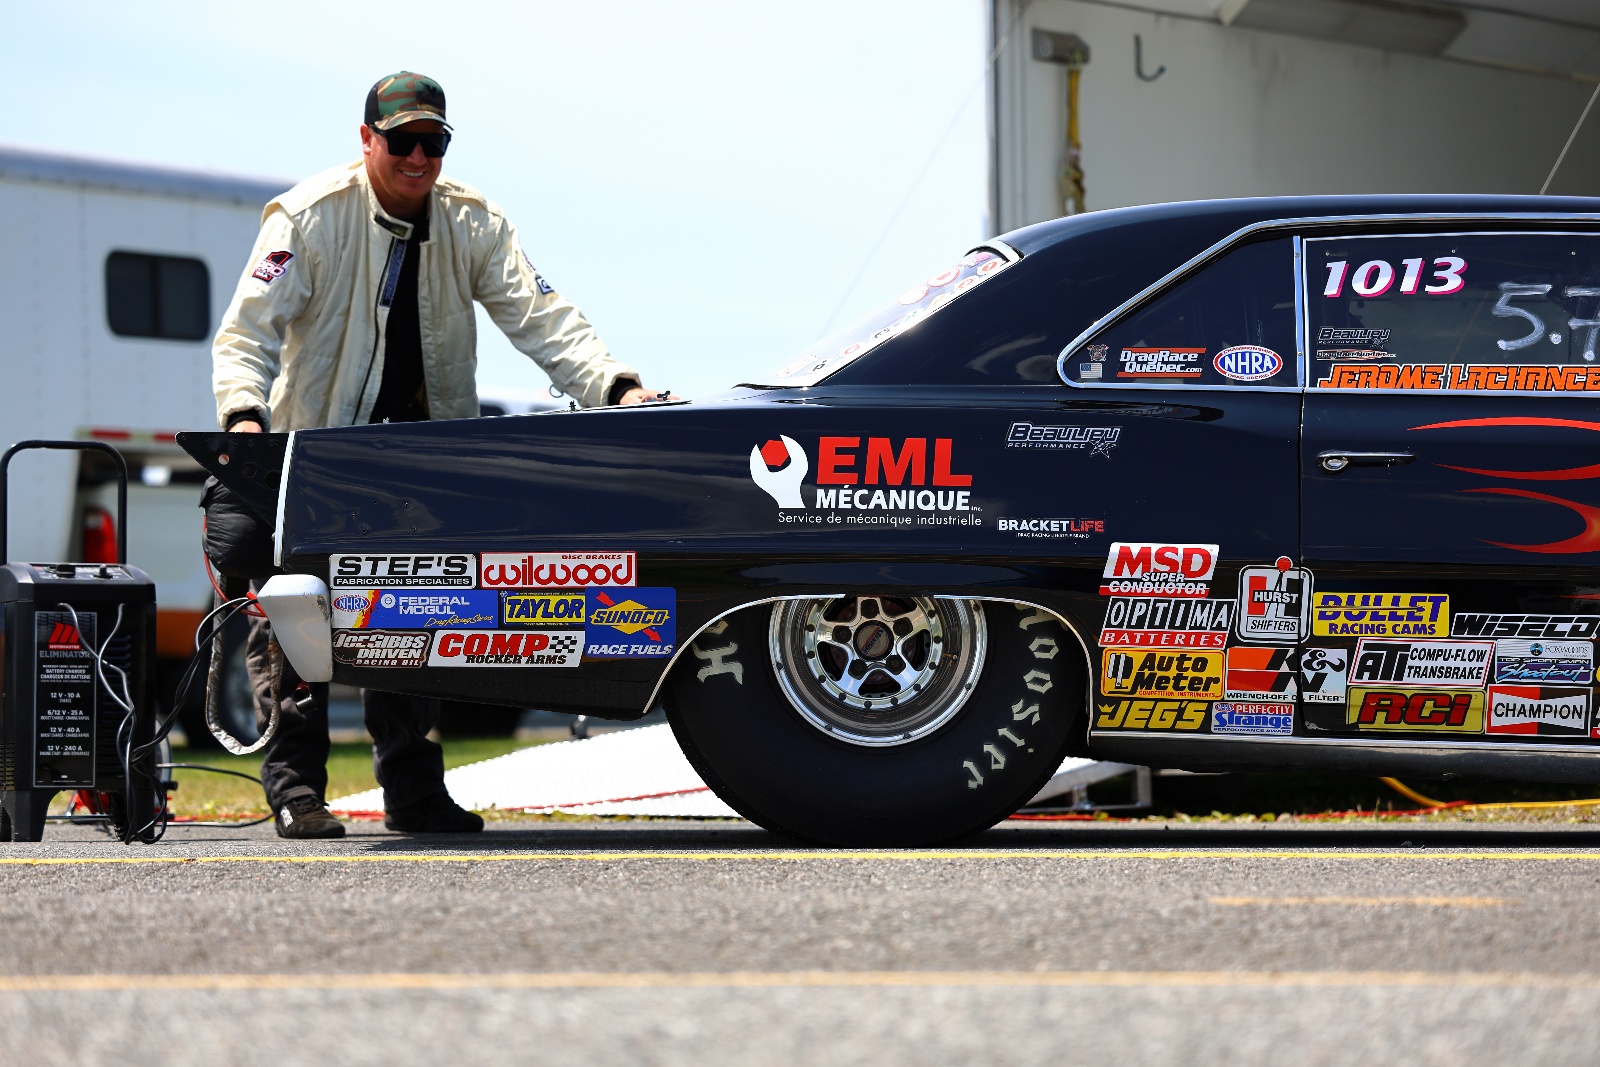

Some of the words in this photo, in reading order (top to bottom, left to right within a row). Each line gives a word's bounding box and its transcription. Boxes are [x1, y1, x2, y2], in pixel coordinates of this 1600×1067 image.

[1324, 257, 1468, 298] 1013
[1224, 352, 1274, 374] NHRA
[1319, 365, 1444, 389] JEROME
[816, 436, 973, 487] EML
[816, 485, 971, 510] MÉCANIQUE
[778, 512, 822, 524] Service
[826, 512, 842, 524] de
[847, 513, 912, 527] mécanique
[917, 514, 982, 526] industrielle
[337, 556, 468, 576] STEF'S
[1113, 545, 1212, 578] MSD
[484, 555, 632, 585] wilwood
[1141, 572, 1185, 582] SUPER
[1108, 580, 1207, 594] CONDUCTOR
[339, 596, 365, 610] NHRA
[399, 596, 470, 605] FEDERAL
[1253, 591, 1299, 604] HURST
[399, 606, 456, 615] MOGUL
[508, 599, 584, 618] TAYLOR
[1110, 601, 1228, 628] OPTIMA
[1317, 594, 1447, 622] BULLET
[593, 610, 667, 624] SUNOCO
[1250, 619, 1297, 631] SHIFTERS
[1328, 622, 1388, 635] RACING
[1391, 623, 1437, 635] CAMS
[438, 633, 550, 657] COMP
[1103, 632, 1224, 646] BATTERIES
[40, 650, 92, 658] ELIMINATOR
[356, 648, 423, 659] DRIVEN
[587, 644, 628, 655] RACE
[629, 644, 674, 655] FUELS
[1410, 647, 1488, 663] COMPU-FLOW
[465, 654, 522, 664] ROCKER
[525, 655, 567, 665] ARMS
[1137, 652, 1209, 672] Auto
[1406, 665, 1485, 680] TRANSBRAKE
[1133, 672, 1221, 692] Meter
[1226, 692, 1289, 700] WRENCH-OFF
[1308, 694, 1340, 702] FILTER
[1096, 700, 1209, 730] JEG'S
[1236, 704, 1291, 715] PERFECTLY
[1493, 702, 1584, 720] CHAMPION
[1214, 710, 1292, 729] Strange
